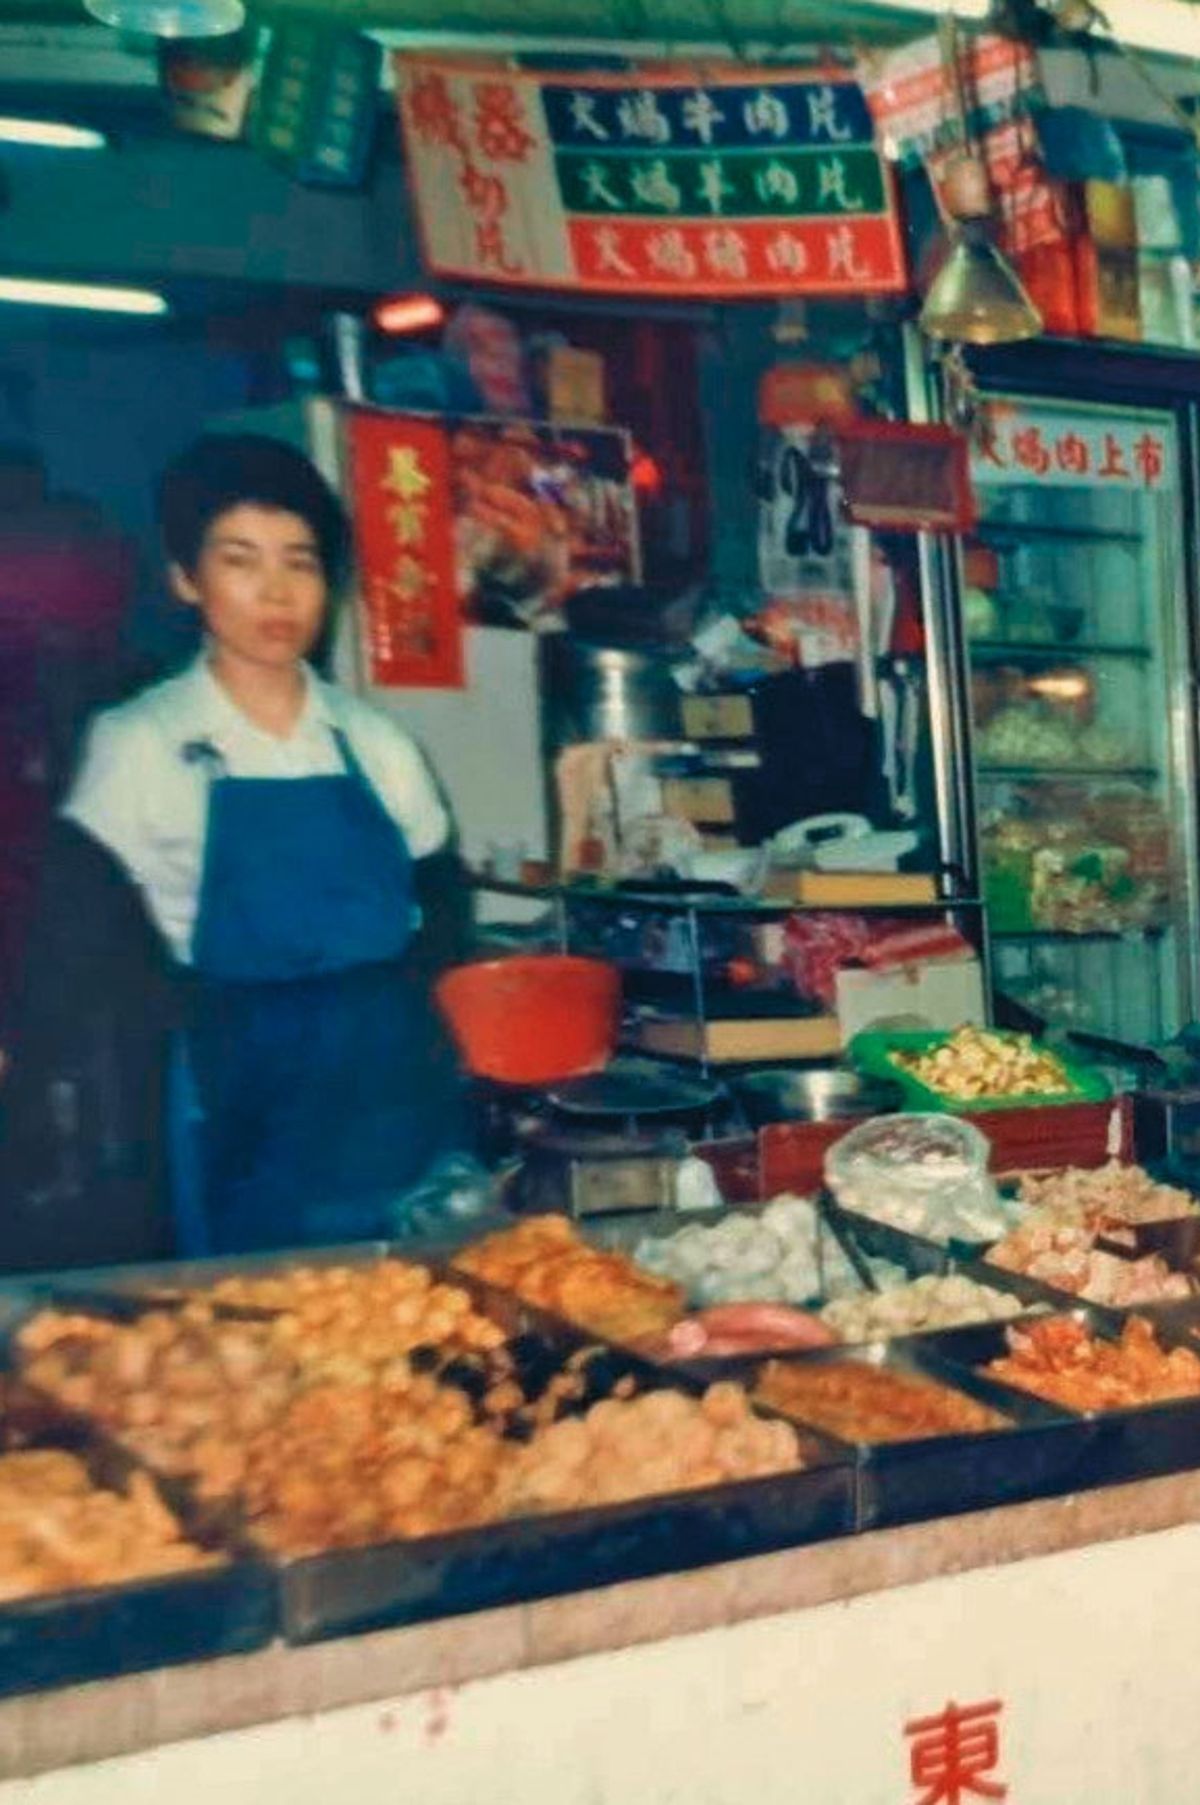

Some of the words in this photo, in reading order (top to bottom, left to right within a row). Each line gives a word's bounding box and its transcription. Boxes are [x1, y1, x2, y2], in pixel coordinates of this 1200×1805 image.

[568, 88, 852, 145] 火鍋牛肉片
[578, 157, 862, 213] 火鍋羊肉片
[903, 1699, 1008, 1805] 東
